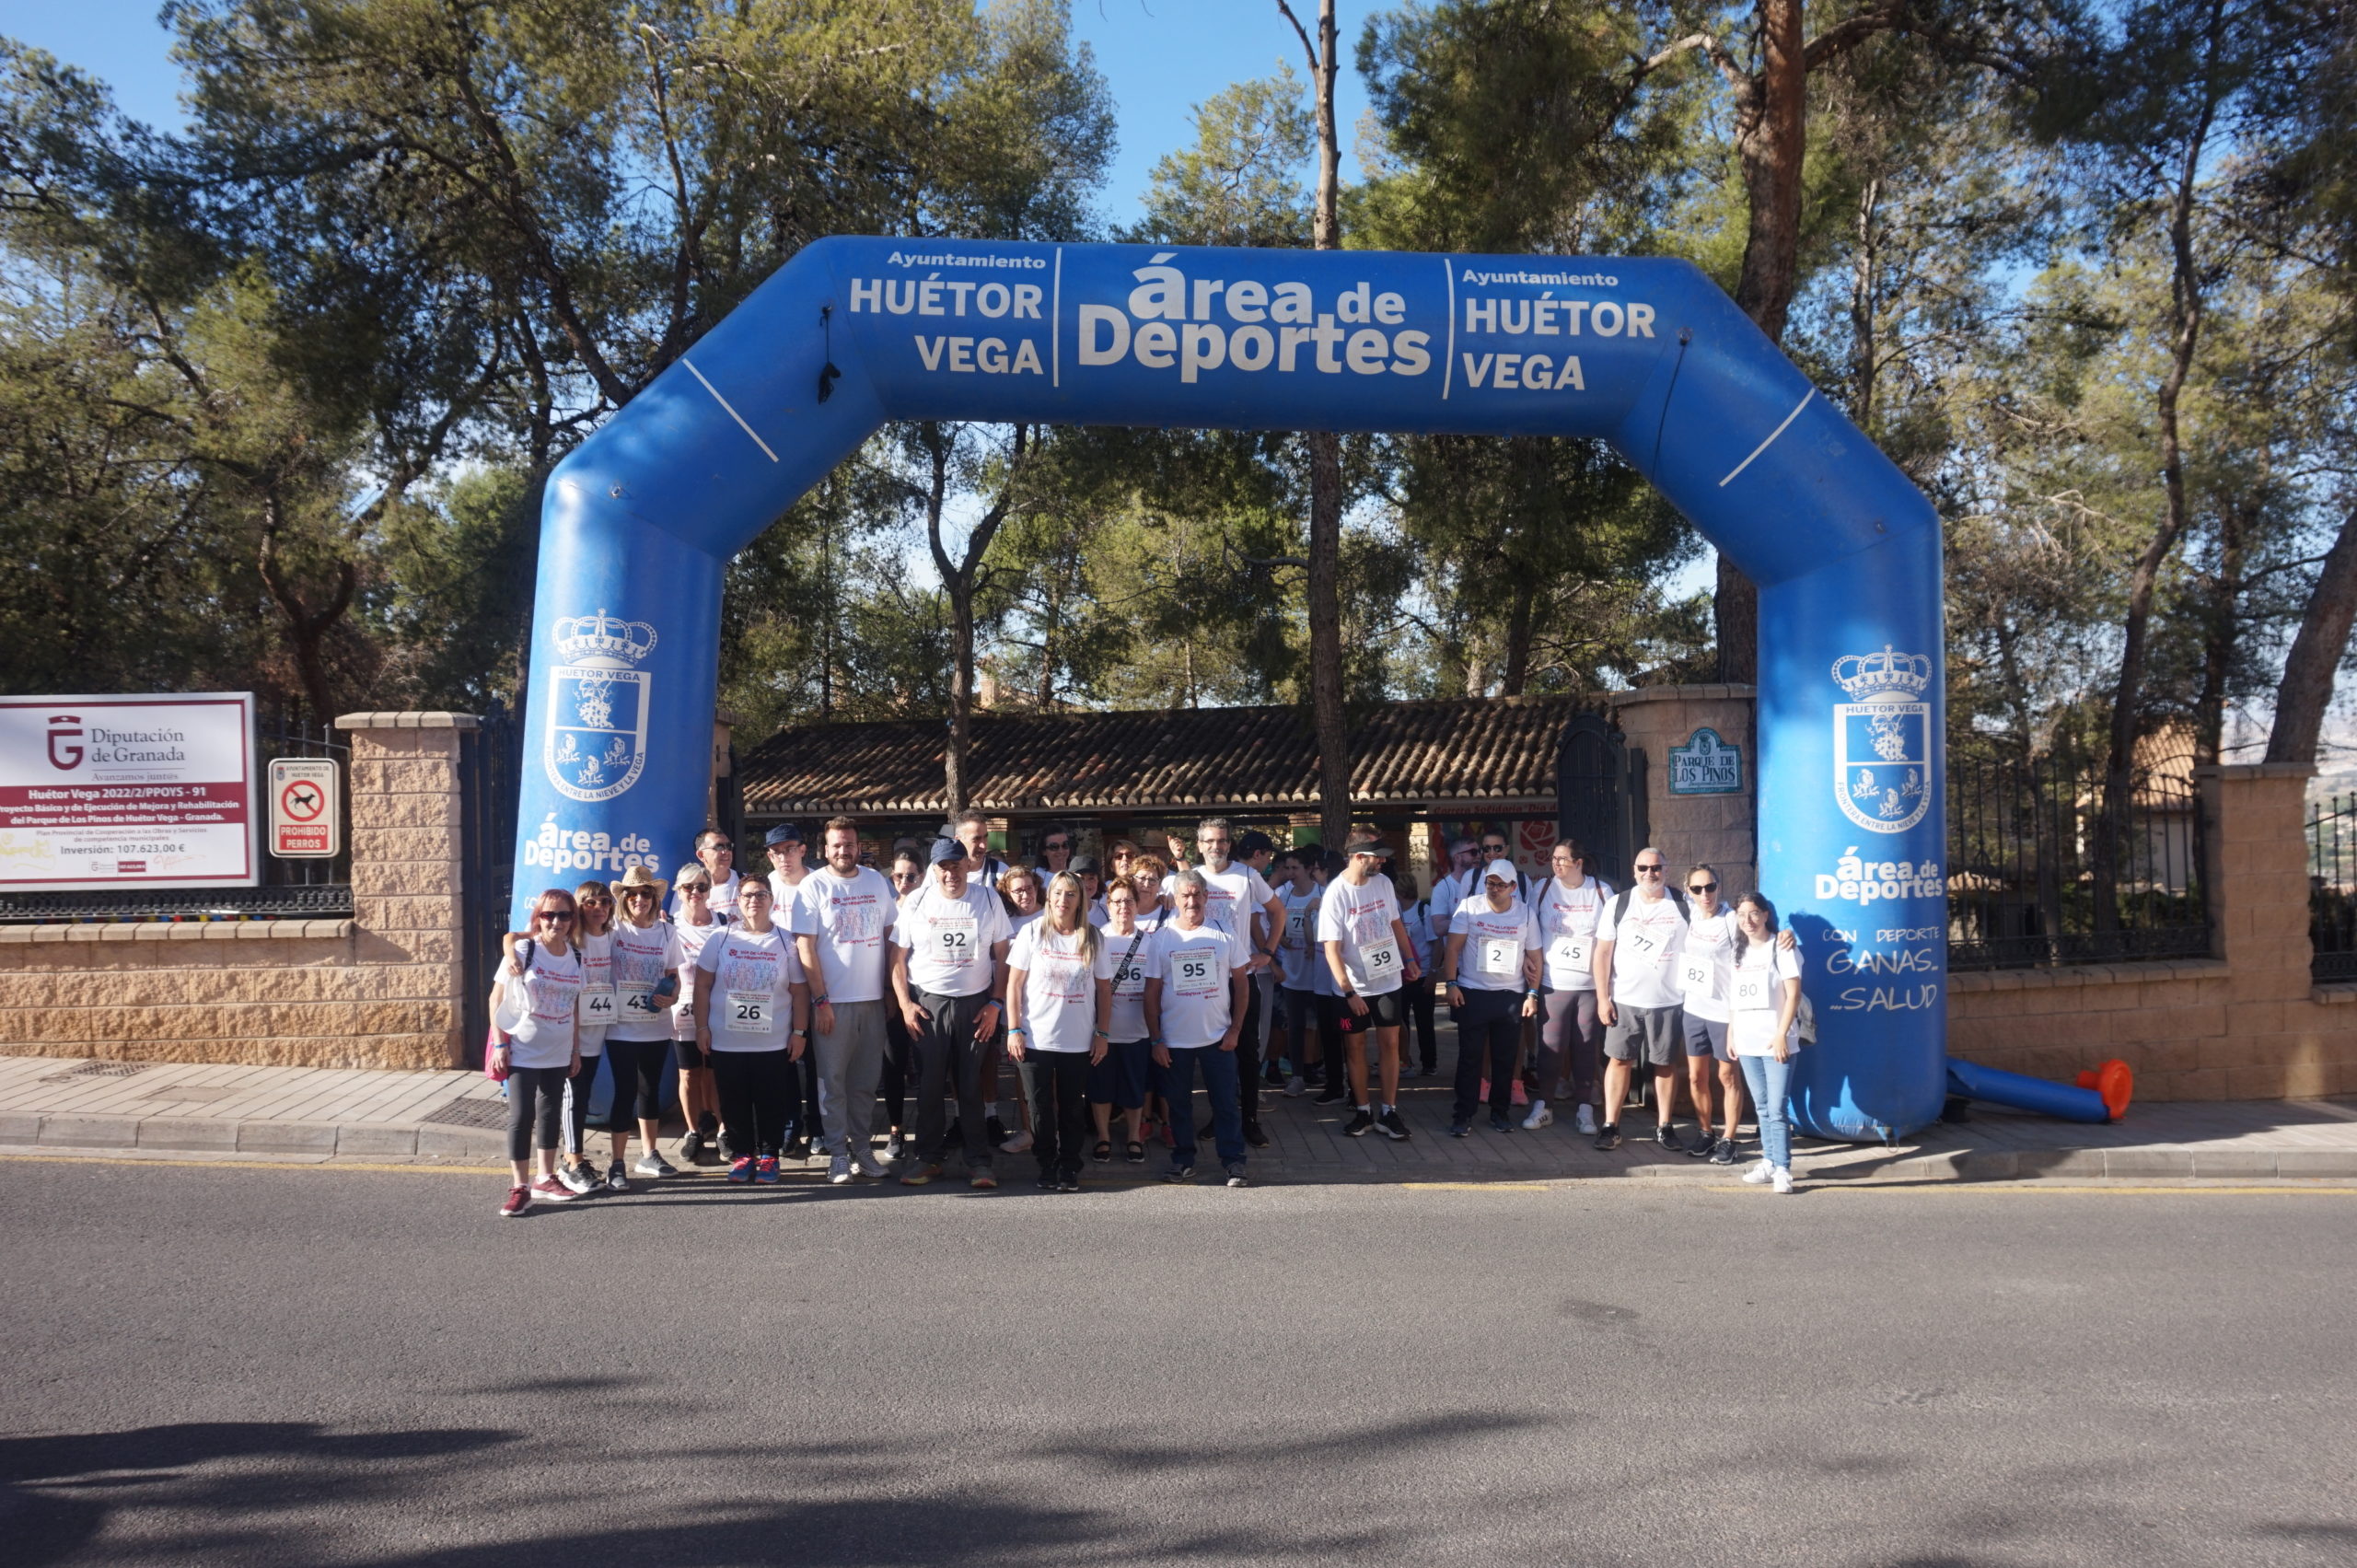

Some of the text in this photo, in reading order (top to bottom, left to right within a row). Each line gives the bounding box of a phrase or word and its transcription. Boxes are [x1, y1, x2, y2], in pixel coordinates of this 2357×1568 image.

[888, 251, 1046, 269] Ayuntamiento
[1462, 269, 1619, 286] Ayuntamiento
[1128, 252, 1406, 324] área de
[850, 273, 1042, 319] HUÉTOR
[1466, 291, 1655, 338] HUÉTOR
[1078, 304, 1432, 383] Deportes
[914, 335, 1043, 375] VEGA
[1462, 353, 1585, 390] VEGA
[559, 668, 641, 682] HUETOR VEGA
[1846, 704, 1924, 714] HUETOR VEGA
[90, 727, 184, 747] Diputación
[91, 747, 185, 762] de Granada
[1675, 755, 1736, 767] PARQUE DE
[92, 773, 145, 782] Avanzamos
[596, 786, 619, 799] NIEVE
[631, 751, 644, 775] VEGA
[1675, 766, 1736, 783] LOS PINOS
[29, 789, 69, 799] Huétor
[71, 789, 100, 801] Vega
[102, 787, 183, 798] 2022/2/PPOYS
[192, 787, 206, 796] 91
[0, 806, 34, 814] royecto
[27, 817, 57, 825] Parque
[157, 814, 179, 823] Vega
[281, 826, 326, 836] PROHIBIDO
[538, 812, 650, 853] área de
[61, 843, 185, 854] Inversión: 107.623,00 €
[287, 839, 320, 848] PERROS
[524, 840, 659, 874] Deportes
[1836, 846, 1938, 881] área de
[1816, 874, 1943, 906] Deportes
[524, 896, 538, 910] CO
[1293, 917, 1304, 928] 7
[943, 933, 966, 947] 92
[1823, 926, 1940, 943] CON DEPORTE
[1634, 935, 1654, 952] 77
[1372, 950, 1391, 967] 39
[1492, 949, 1502, 962] 2
[1561, 946, 1581, 959] 45
[1182, 962, 1205, 978] 95
[1688, 968, 1705, 983] 82
[1739, 983, 1758, 997] 80
[590, 997, 611, 1012] 44
[627, 995, 648, 1009] 43
[679, 1004, 694, 1016] 3
[737, 1005, 761, 1020] 26
